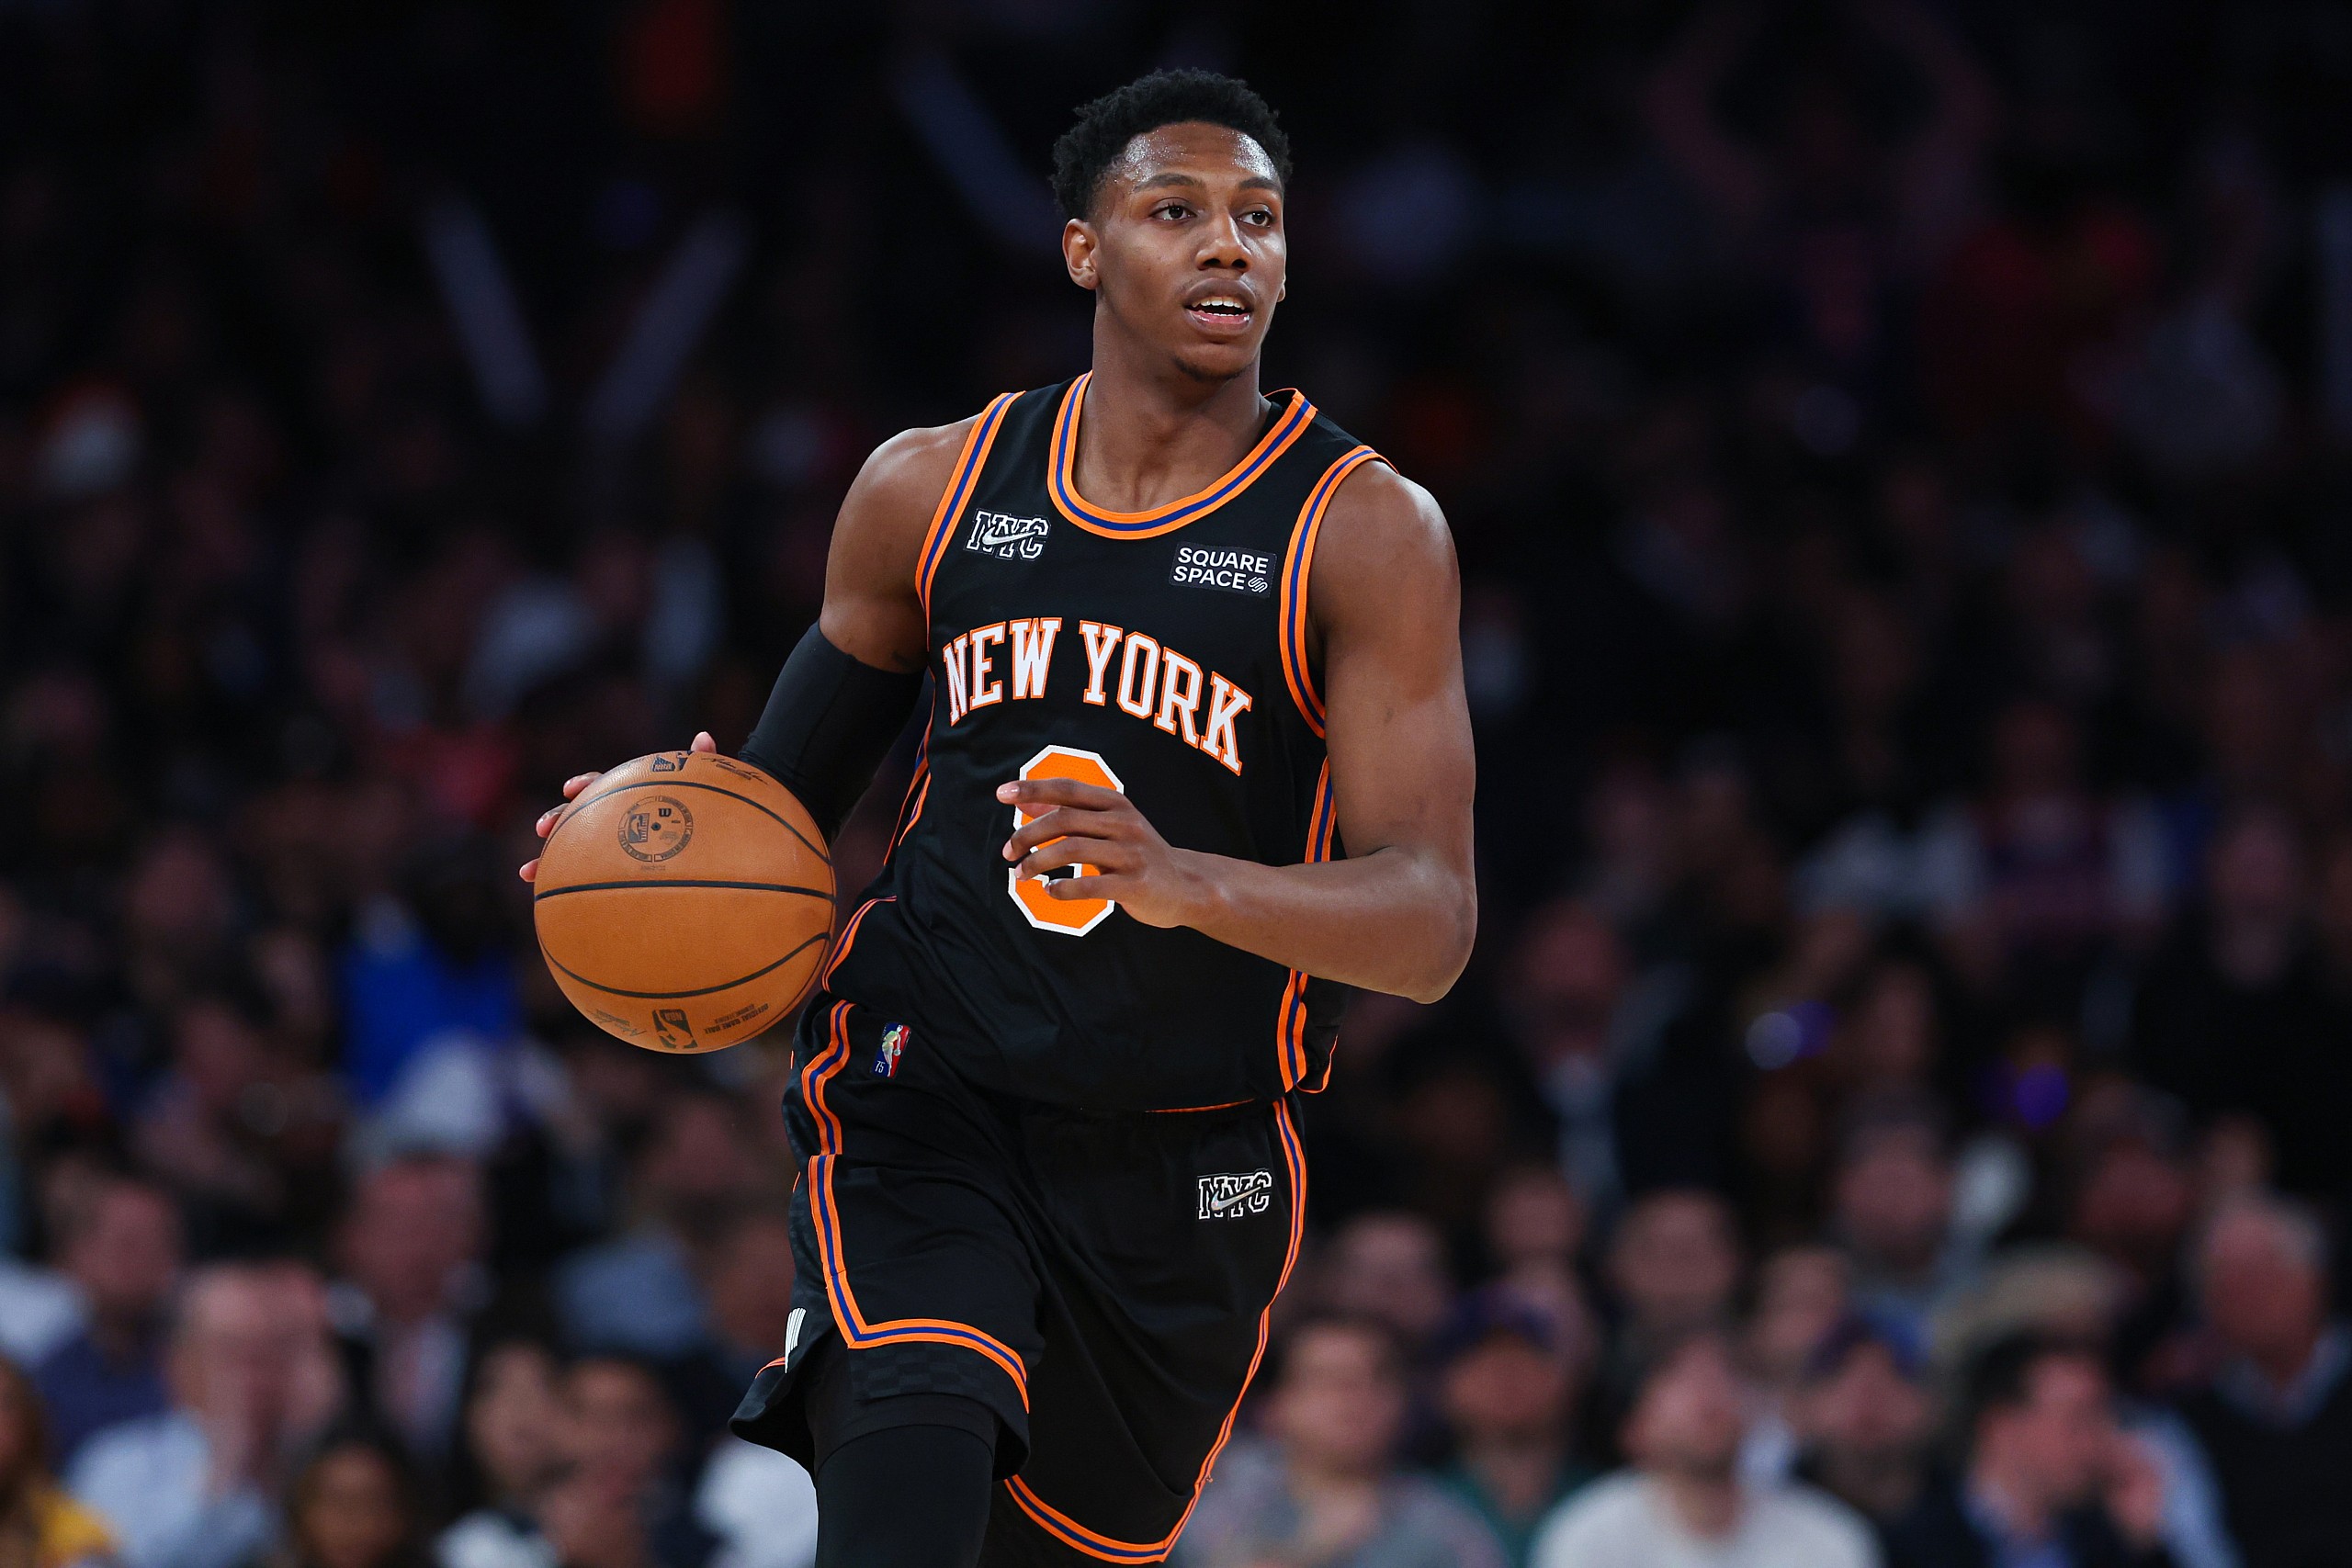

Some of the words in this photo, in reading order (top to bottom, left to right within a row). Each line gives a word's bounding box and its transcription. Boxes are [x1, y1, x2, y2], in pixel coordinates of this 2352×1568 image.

[967, 510, 1048, 558] NYC
[1173, 566, 1245, 590] SPACE
[1178, 547, 1269, 574] SQUARE
[943, 617, 1062, 727] NEW
[1079, 619, 1252, 775] YORK
[875, 1060, 886, 1073] 75
[1198, 1171, 1272, 1220] NYC
